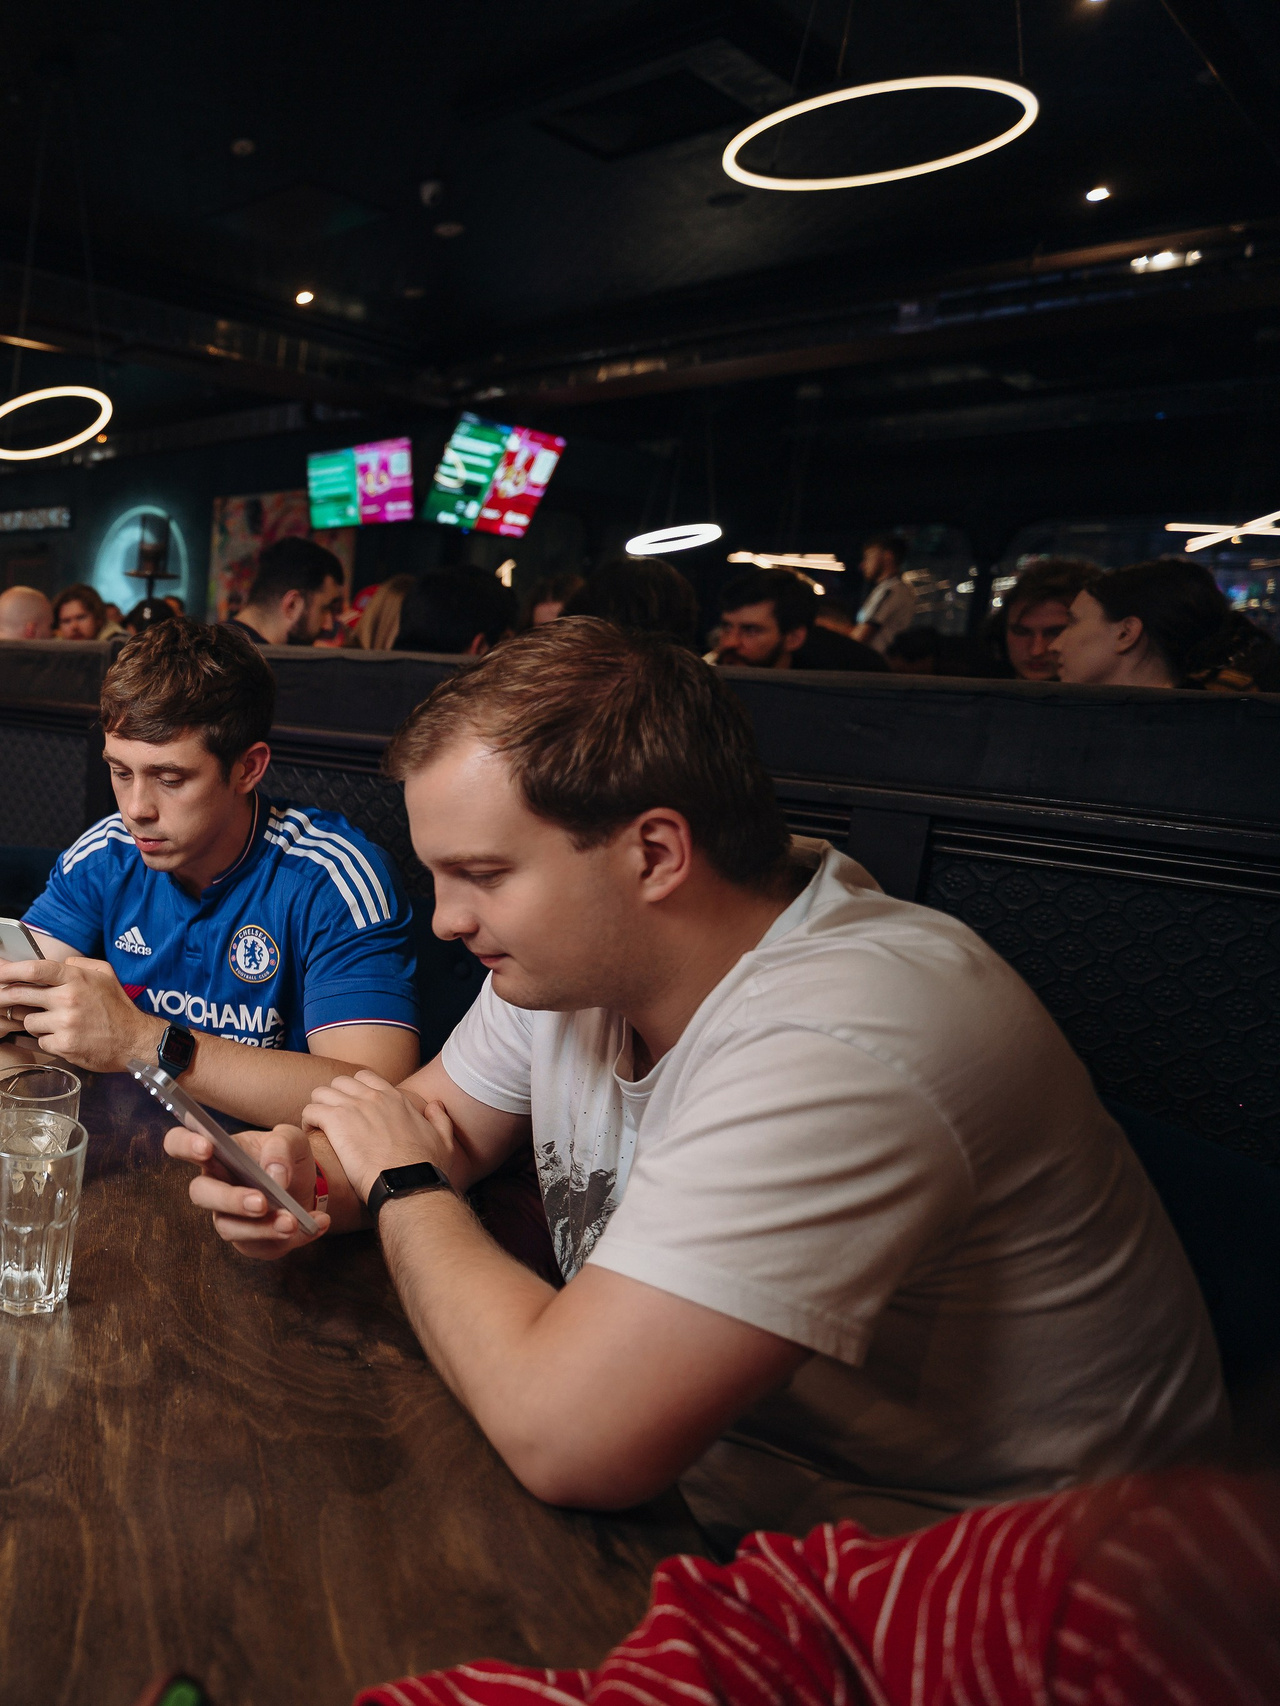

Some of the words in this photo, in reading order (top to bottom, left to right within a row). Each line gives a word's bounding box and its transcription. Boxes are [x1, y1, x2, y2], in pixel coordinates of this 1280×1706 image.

[238, 928, 267, 943] CHELSEA
[114, 940, 152, 956] adidas
[235, 967, 257, 981] FOOTBALL
[258, 970, 270, 980] CLUB
